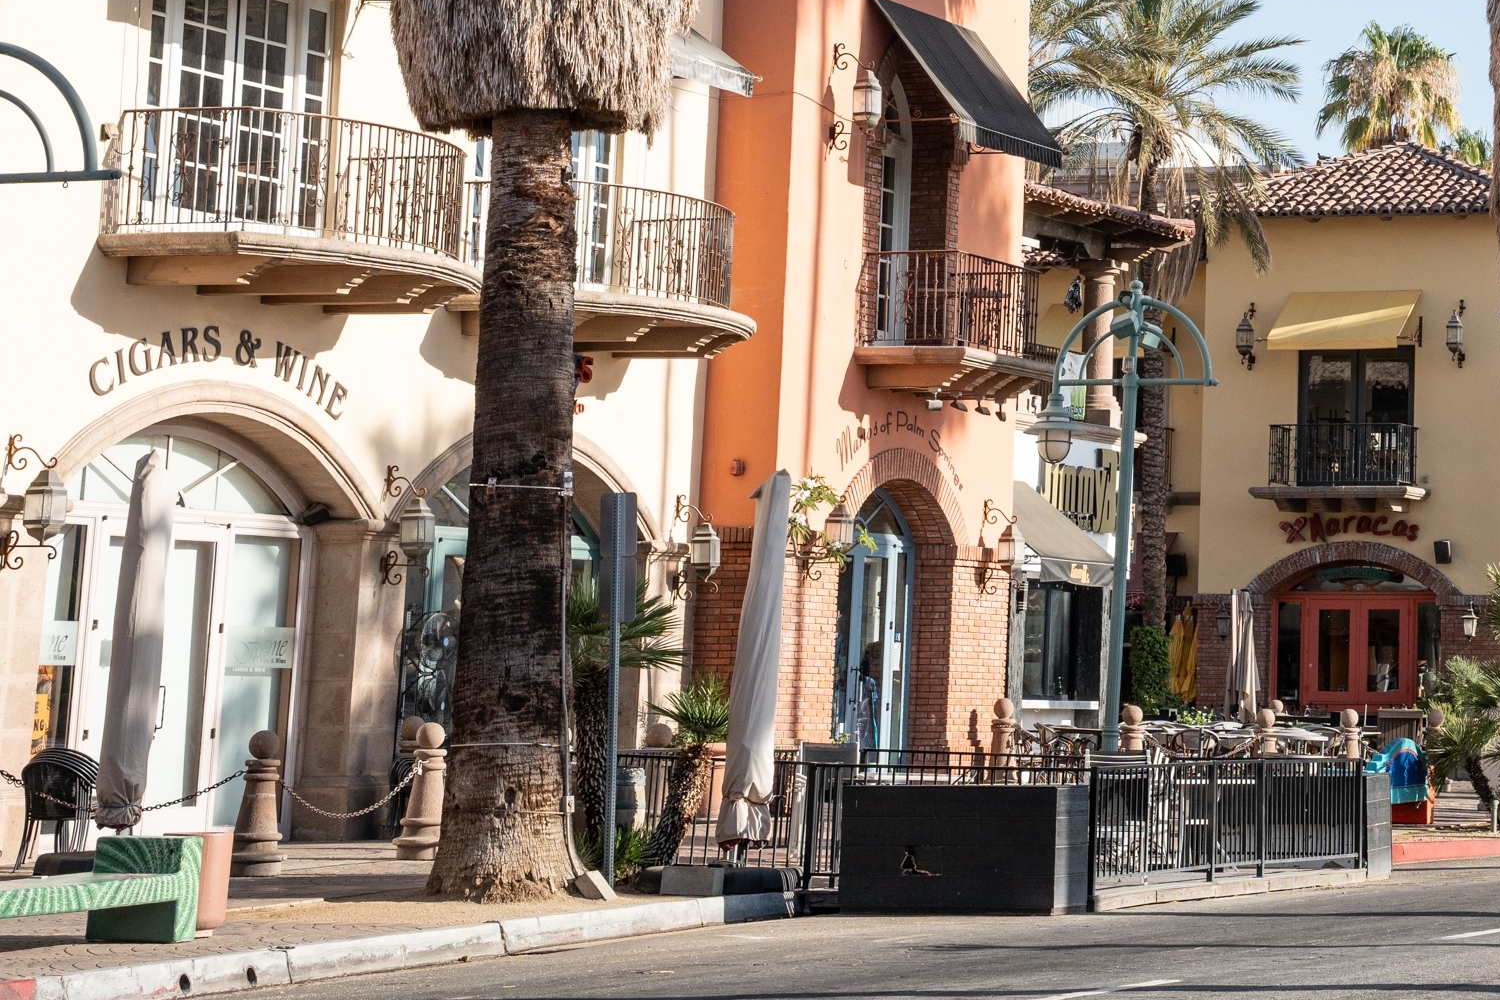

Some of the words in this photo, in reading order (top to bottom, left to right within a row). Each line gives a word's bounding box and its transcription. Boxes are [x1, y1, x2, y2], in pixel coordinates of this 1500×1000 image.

[88, 325, 221, 397] CIGARS
[234, 329, 262, 369] &
[274, 340, 349, 421] WINE
[880, 412, 893, 435] of
[896, 410, 925, 438] Palm
[1309, 512, 1420, 542] Maracas
